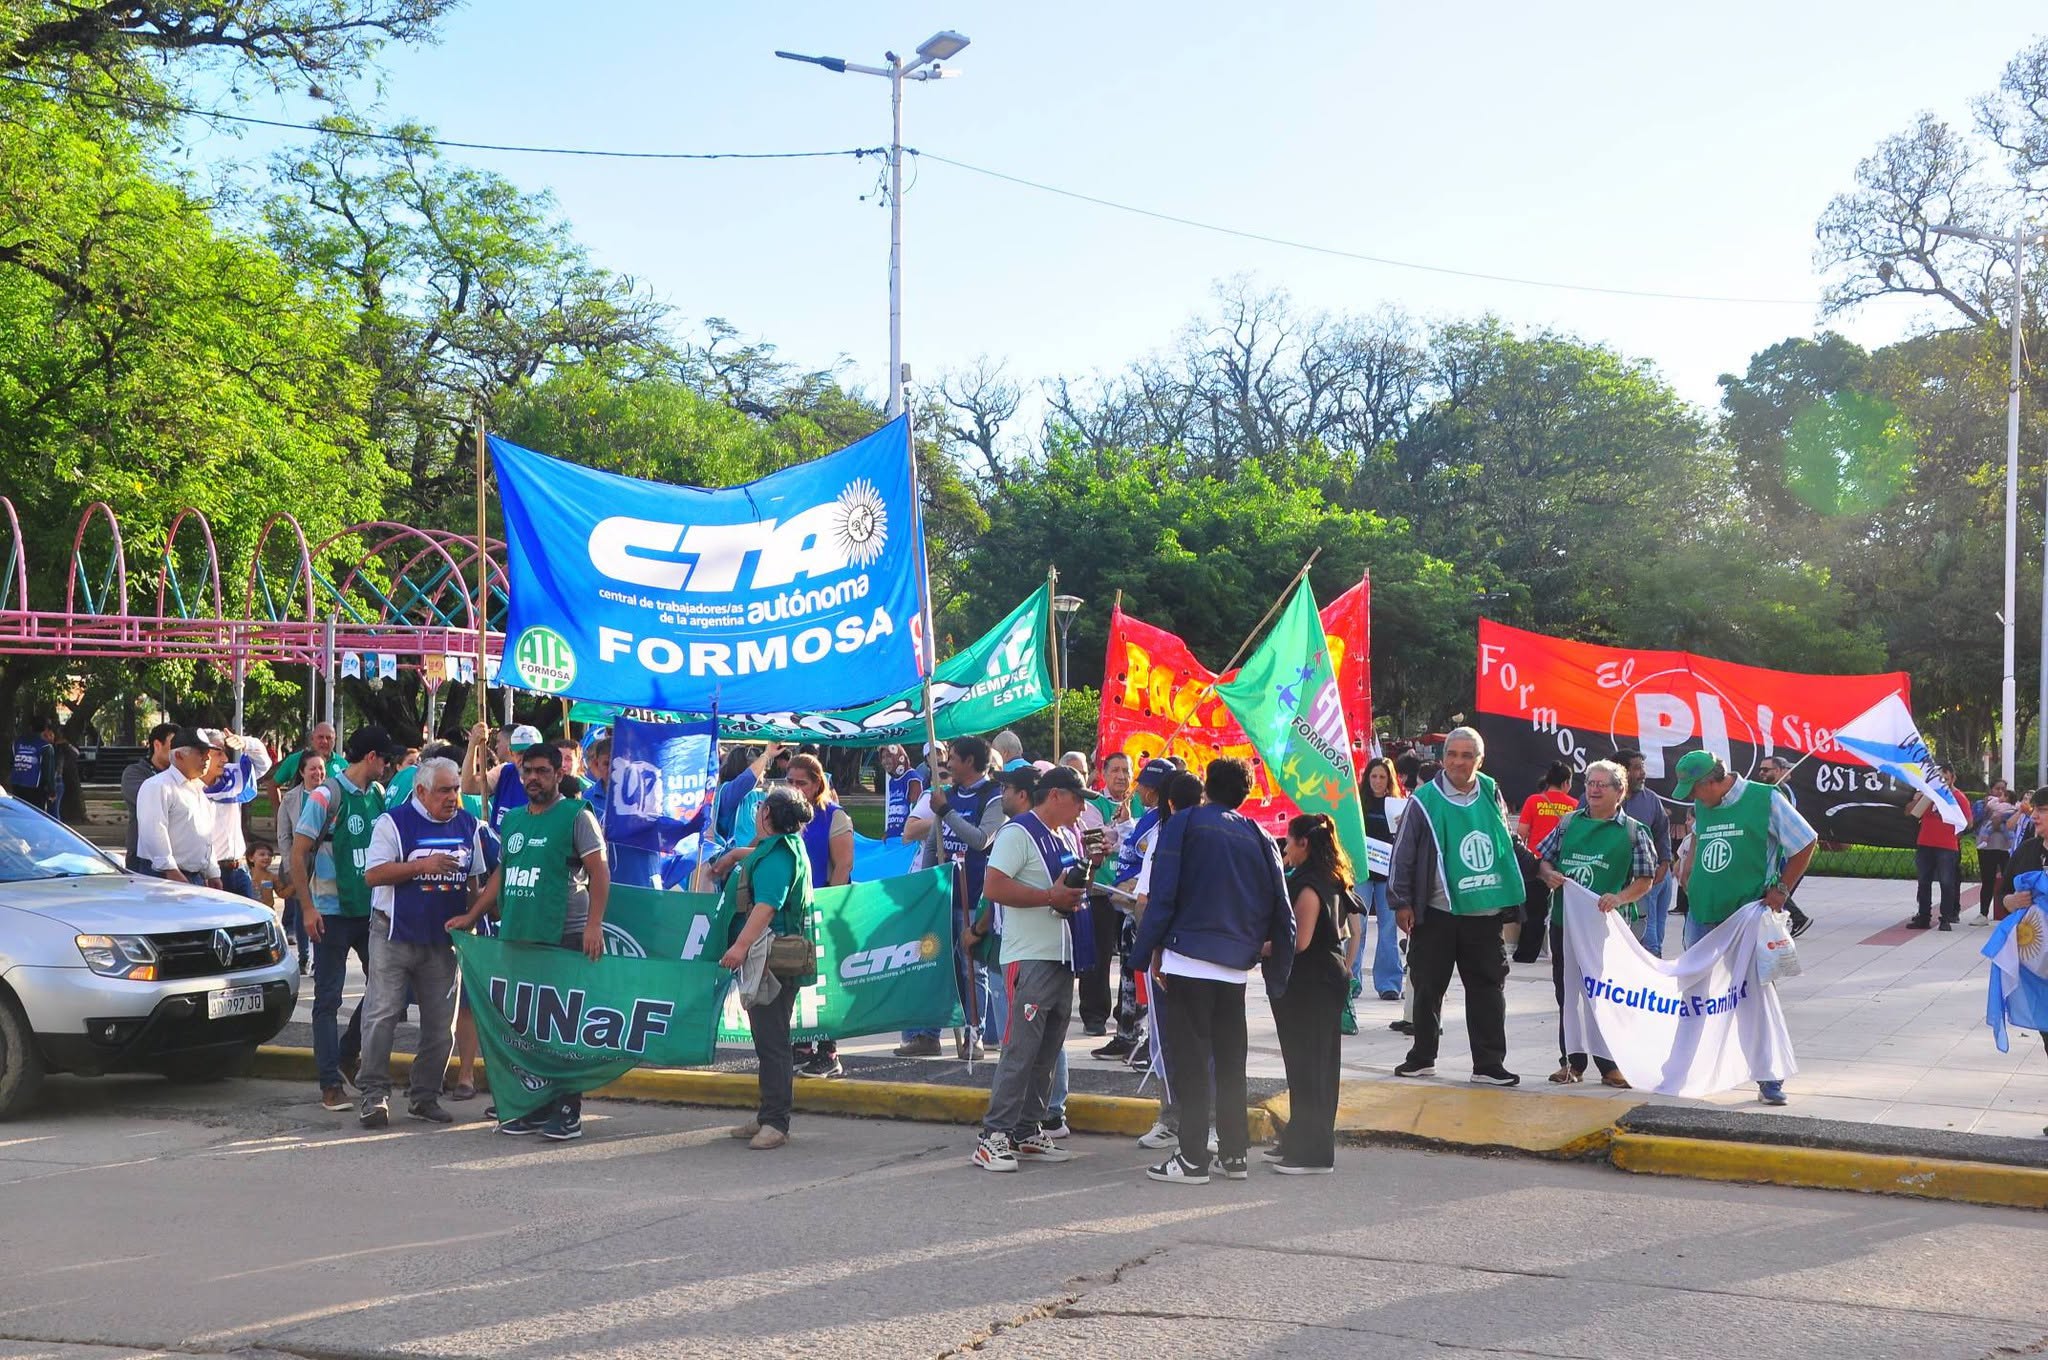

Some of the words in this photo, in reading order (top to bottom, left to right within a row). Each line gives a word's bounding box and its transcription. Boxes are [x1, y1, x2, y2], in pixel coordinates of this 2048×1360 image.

[588, 501, 848, 592] CTA
[599, 589, 637, 606] central
[640, 597, 654, 609] de
[656, 600, 744, 616] trabajadores/as
[747, 573, 869, 625] autónoma
[659, 611, 674, 624] de
[676, 614, 687, 625] la
[690, 615, 744, 629] argentina
[599, 605, 893, 676] FORMOSA
[521, 663, 570, 680] FORMOSA
[1596, 657, 1635, 688] El
[993, 681, 1036, 707] ESTA
[1480, 643, 1587, 774] Formos
[1290, 715, 1351, 778] FORMOSA
[1634, 691, 1732, 779] PI
[1462, 833, 1492, 869] ATE
[1703, 841, 1728, 869] ATE
[840, 940, 922, 979] CTA
[228, 997, 245, 1012] 997
[248, 995, 261, 1010] JQ
[490, 976, 675, 1053] UNaF
[1584, 975, 1691, 1017] gricultura
